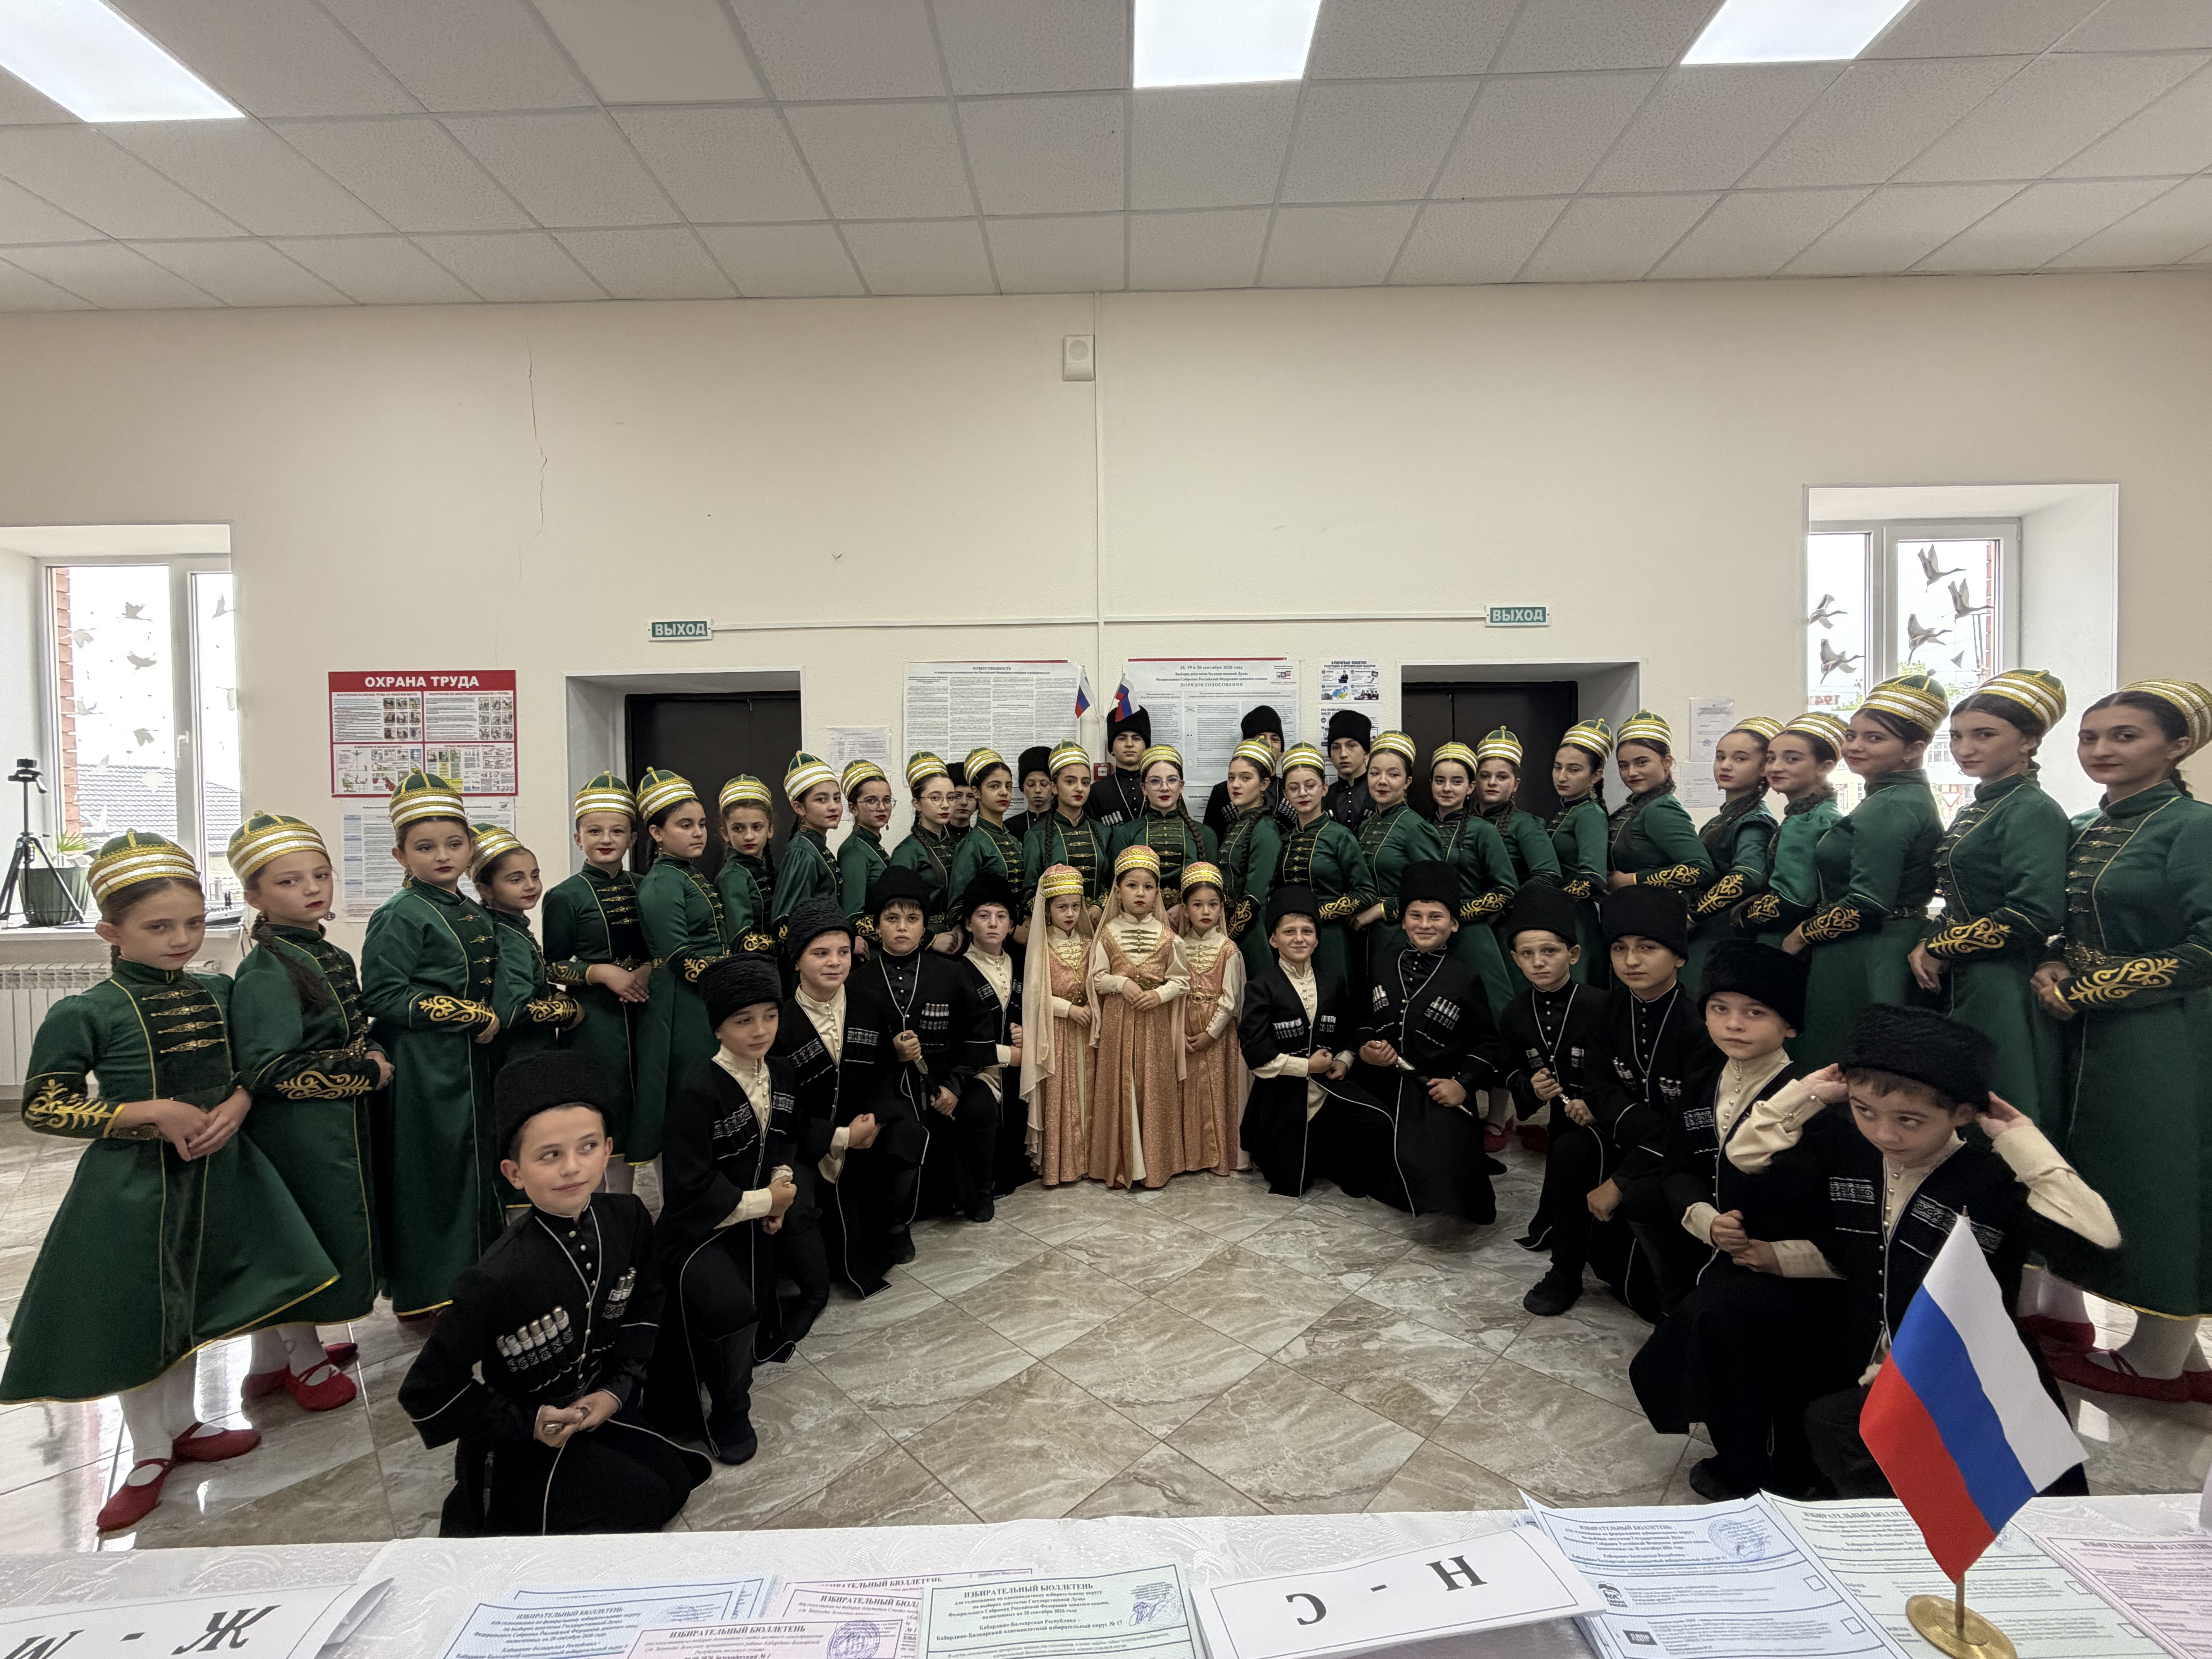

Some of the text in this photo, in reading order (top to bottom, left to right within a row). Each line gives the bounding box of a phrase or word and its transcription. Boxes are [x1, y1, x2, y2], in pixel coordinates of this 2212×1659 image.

[1493, 610, 1544, 621] ВЫХОД
[655, 623, 706, 636] ВЫХОД
[364, 675, 480, 689] ОХРАНА ТРУДА
[1426, 1555, 1488, 1592] Н
[964, 1583, 1093, 1598] ИЗБИРАТЕЛЬНЫЙ БЮЛЛЕТЕНЬ
[820, 1595, 894, 1606] ИЗБИРАТЕЛЬНЫЙ
[516, 1607, 623, 1620] ИЗБИРАТЕЛЬНЫЙ БЮЛЛЕТЕНЬ
[1286, 1593, 1327, 1626] С
[171, 1605, 282, 1656] Ж
[670, 1626, 748, 1638] ИЗБИРАТЕЛЬНЫЙ
